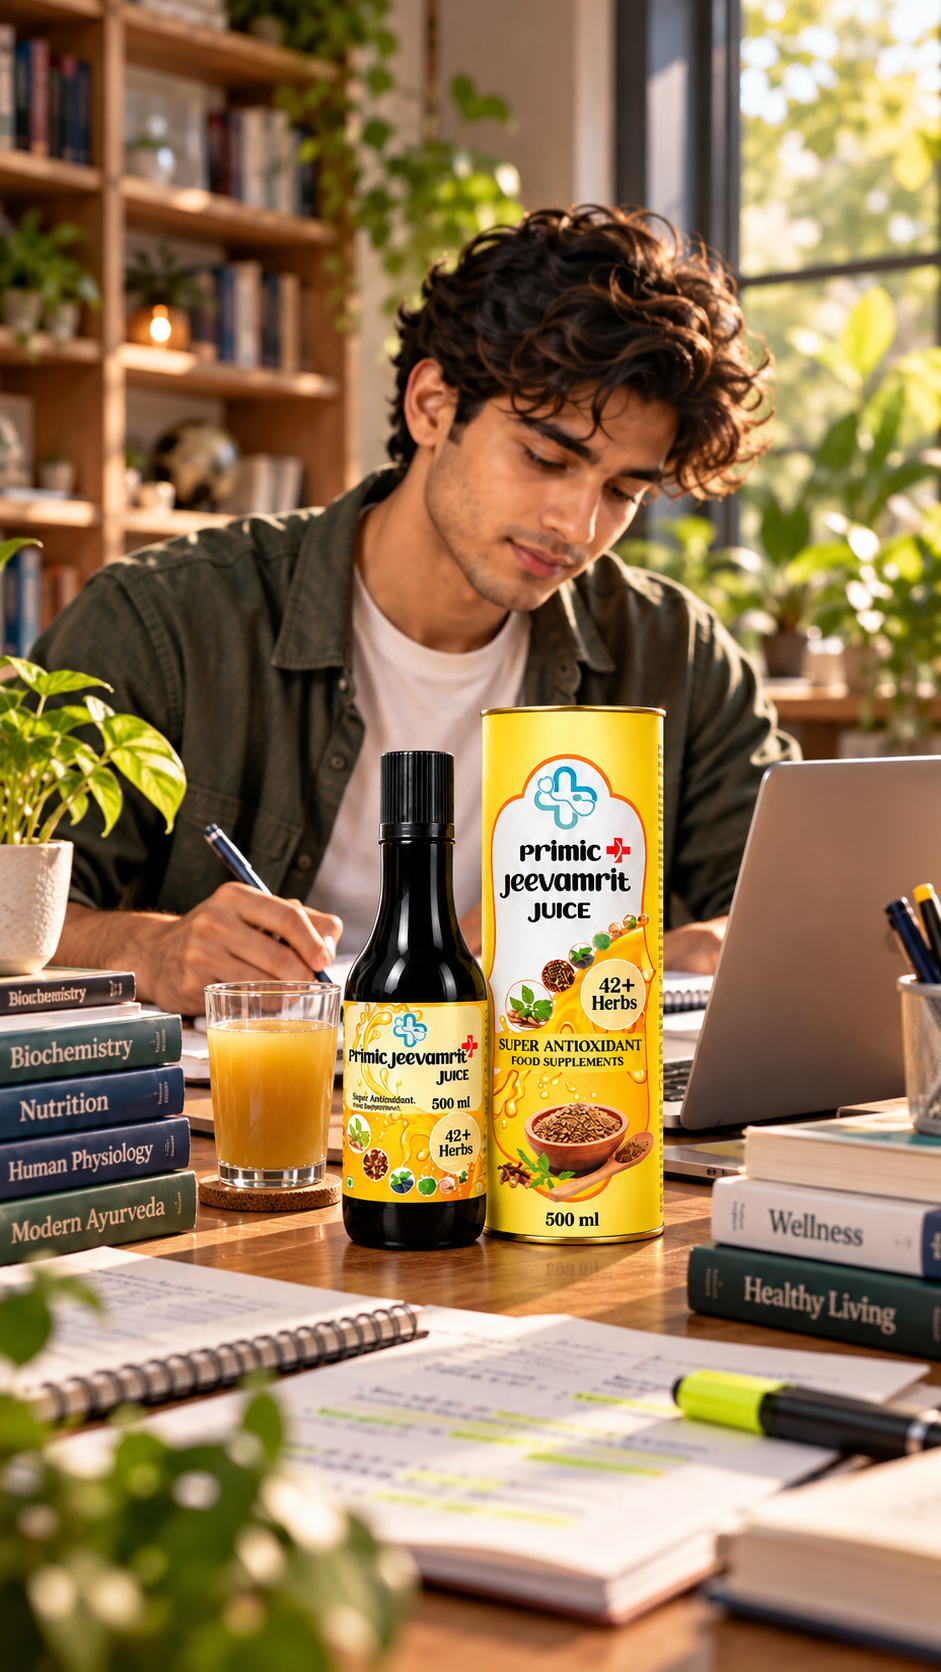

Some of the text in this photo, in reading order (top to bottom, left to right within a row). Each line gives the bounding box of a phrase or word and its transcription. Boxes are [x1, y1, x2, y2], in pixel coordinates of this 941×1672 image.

[527, 902, 591, 923] JUICE
[598, 976, 635, 993] 42+
[591, 995, 638, 1011] Herbs
[9, 1037, 133, 1069] Biochemistry
[498, 1038, 642, 1052] SUPER ANTIOXIDANT
[511, 1056, 624, 1067] FOOD SUPPLEMENTS
[436, 1069, 470, 1085] JUICE
[19, 1092, 109, 1122] Nutrition
[431, 1096, 471, 1110] 500 ml
[445, 1129, 471, 1142] 42+
[439, 1143, 473, 1157] Herbs
[8, 1158, 68, 1182] Human
[71, 1142, 154, 1173] Physiology
[10, 1215, 82, 1244] Modern
[85, 1196, 166, 1233] Ayurveda
[545, 1212, 599, 1227] 500 ml
[768, 1208, 864, 1247] Wellness
[744, 1275, 825, 1320] Healthy
[828, 1289, 897, 1336] Living
